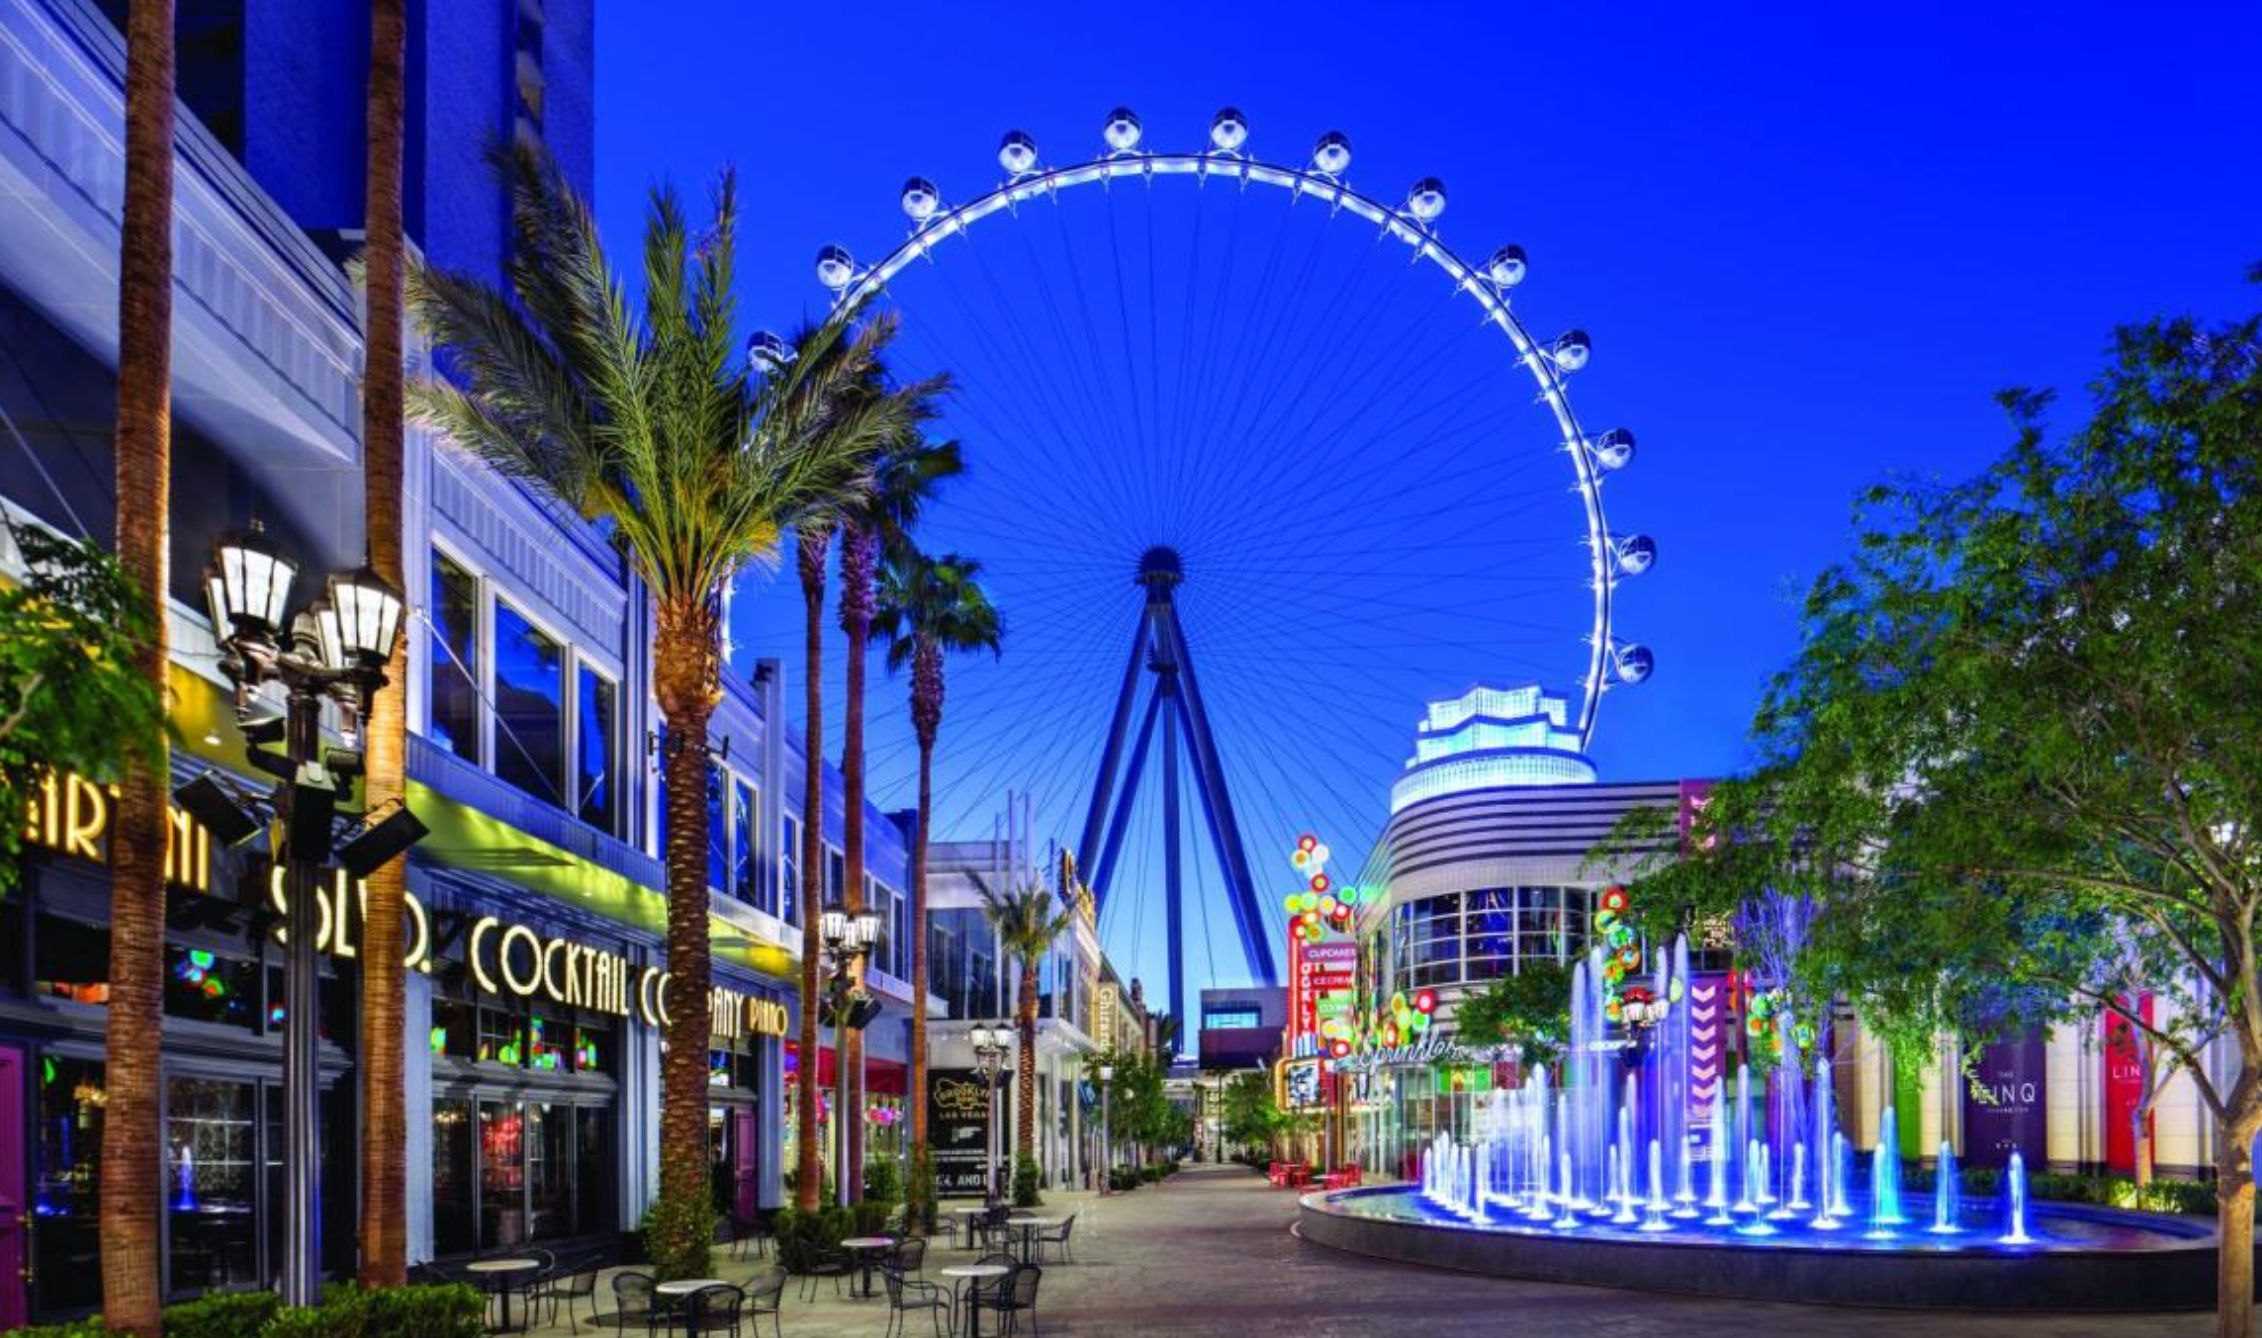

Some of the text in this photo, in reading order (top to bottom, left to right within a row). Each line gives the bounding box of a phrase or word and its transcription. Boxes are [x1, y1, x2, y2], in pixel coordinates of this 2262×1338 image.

[471, 916, 629, 1015] COCKTAIL
[640, 966, 744, 1039] COANY
[2112, 1065, 2141, 1079] LIN
[961, 1110, 987, 1120] VEGA
